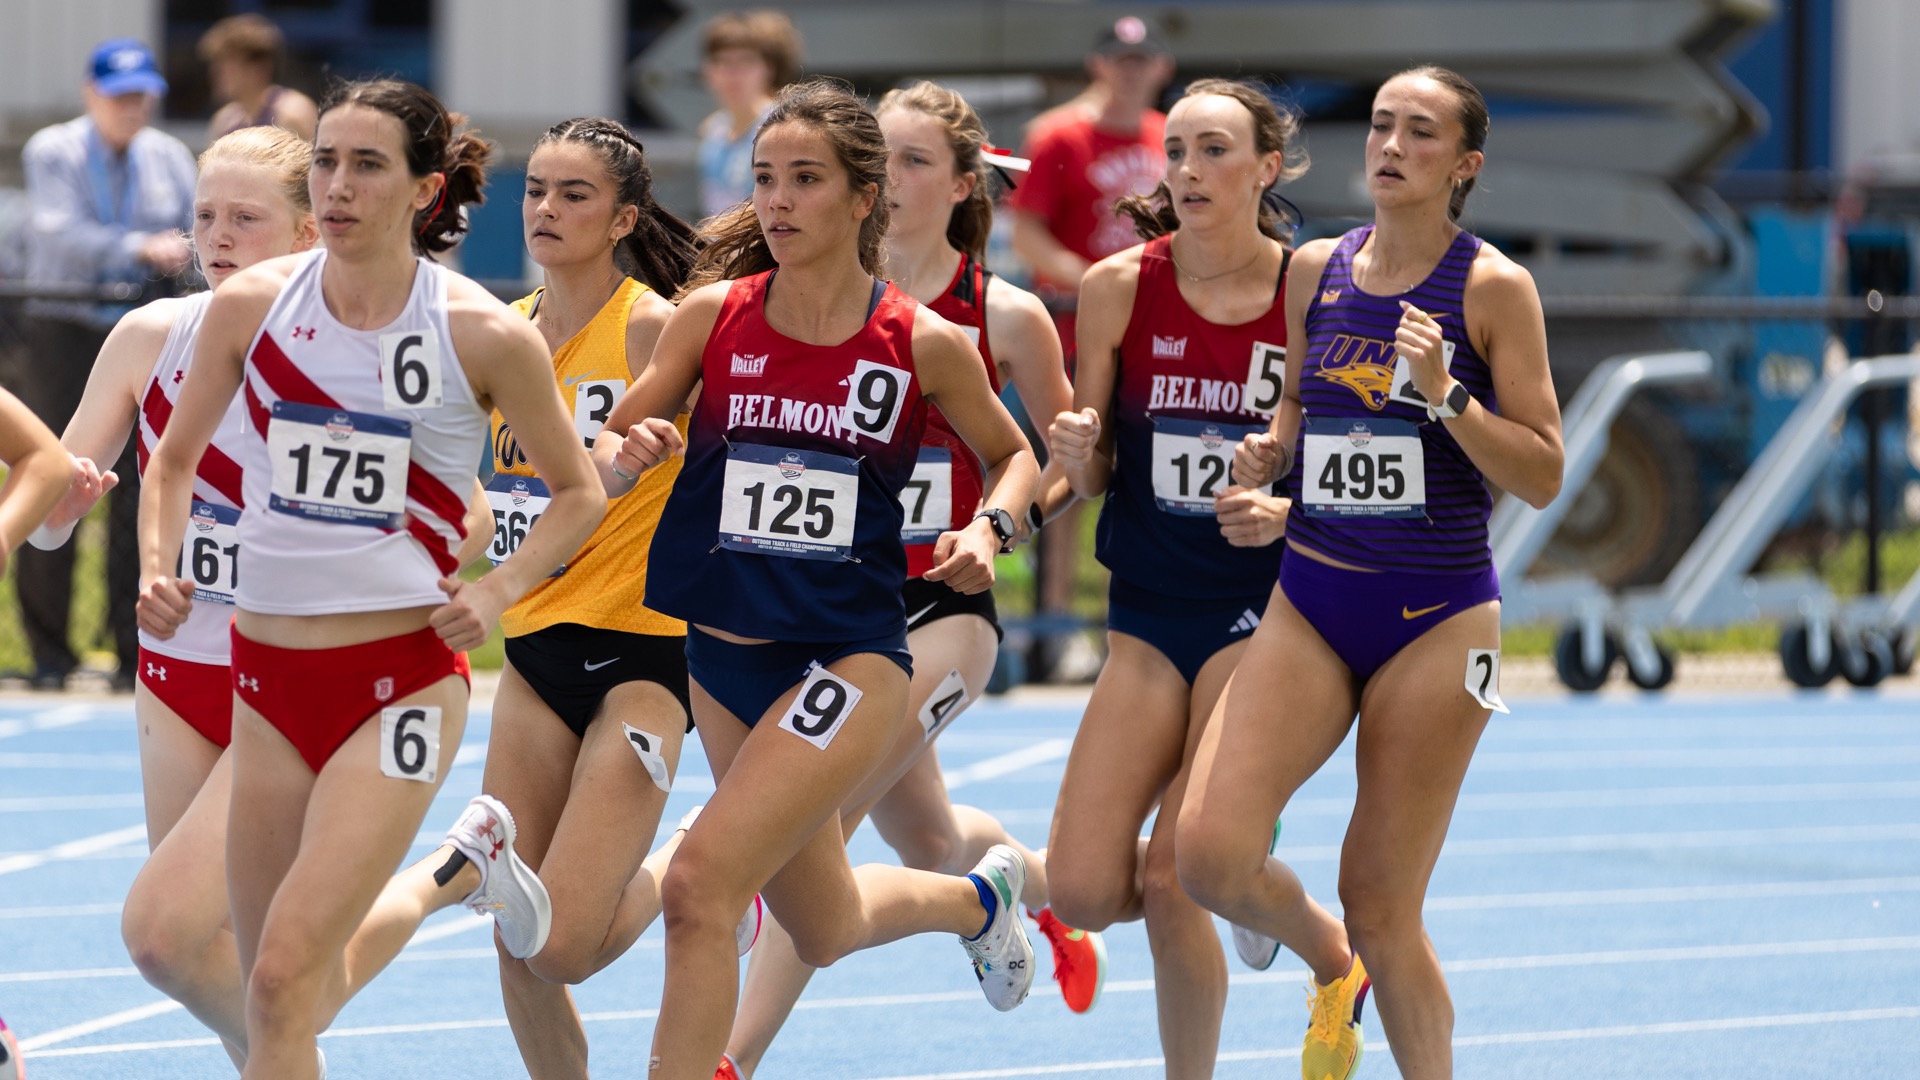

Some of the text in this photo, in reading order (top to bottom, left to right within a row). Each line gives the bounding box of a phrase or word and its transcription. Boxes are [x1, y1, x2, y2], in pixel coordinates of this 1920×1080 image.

[394, 335, 430, 405] 6
[730, 353, 769, 374] VALLEY
[1153, 335, 1188, 357] VALLEY
[853, 369, 899, 434] 9
[1254, 350, 1286, 411] 5
[584, 384, 614, 449] 3
[288, 443, 385, 505] 175
[1171, 453, 1237, 498] 12
[1318, 453, 1405, 501] 495
[491, 509, 542, 557] 56
[743, 482, 834, 539] 125
[792, 679, 847, 736] 9
[927, 688, 965, 734] 4
[394, 709, 427, 775] 6
